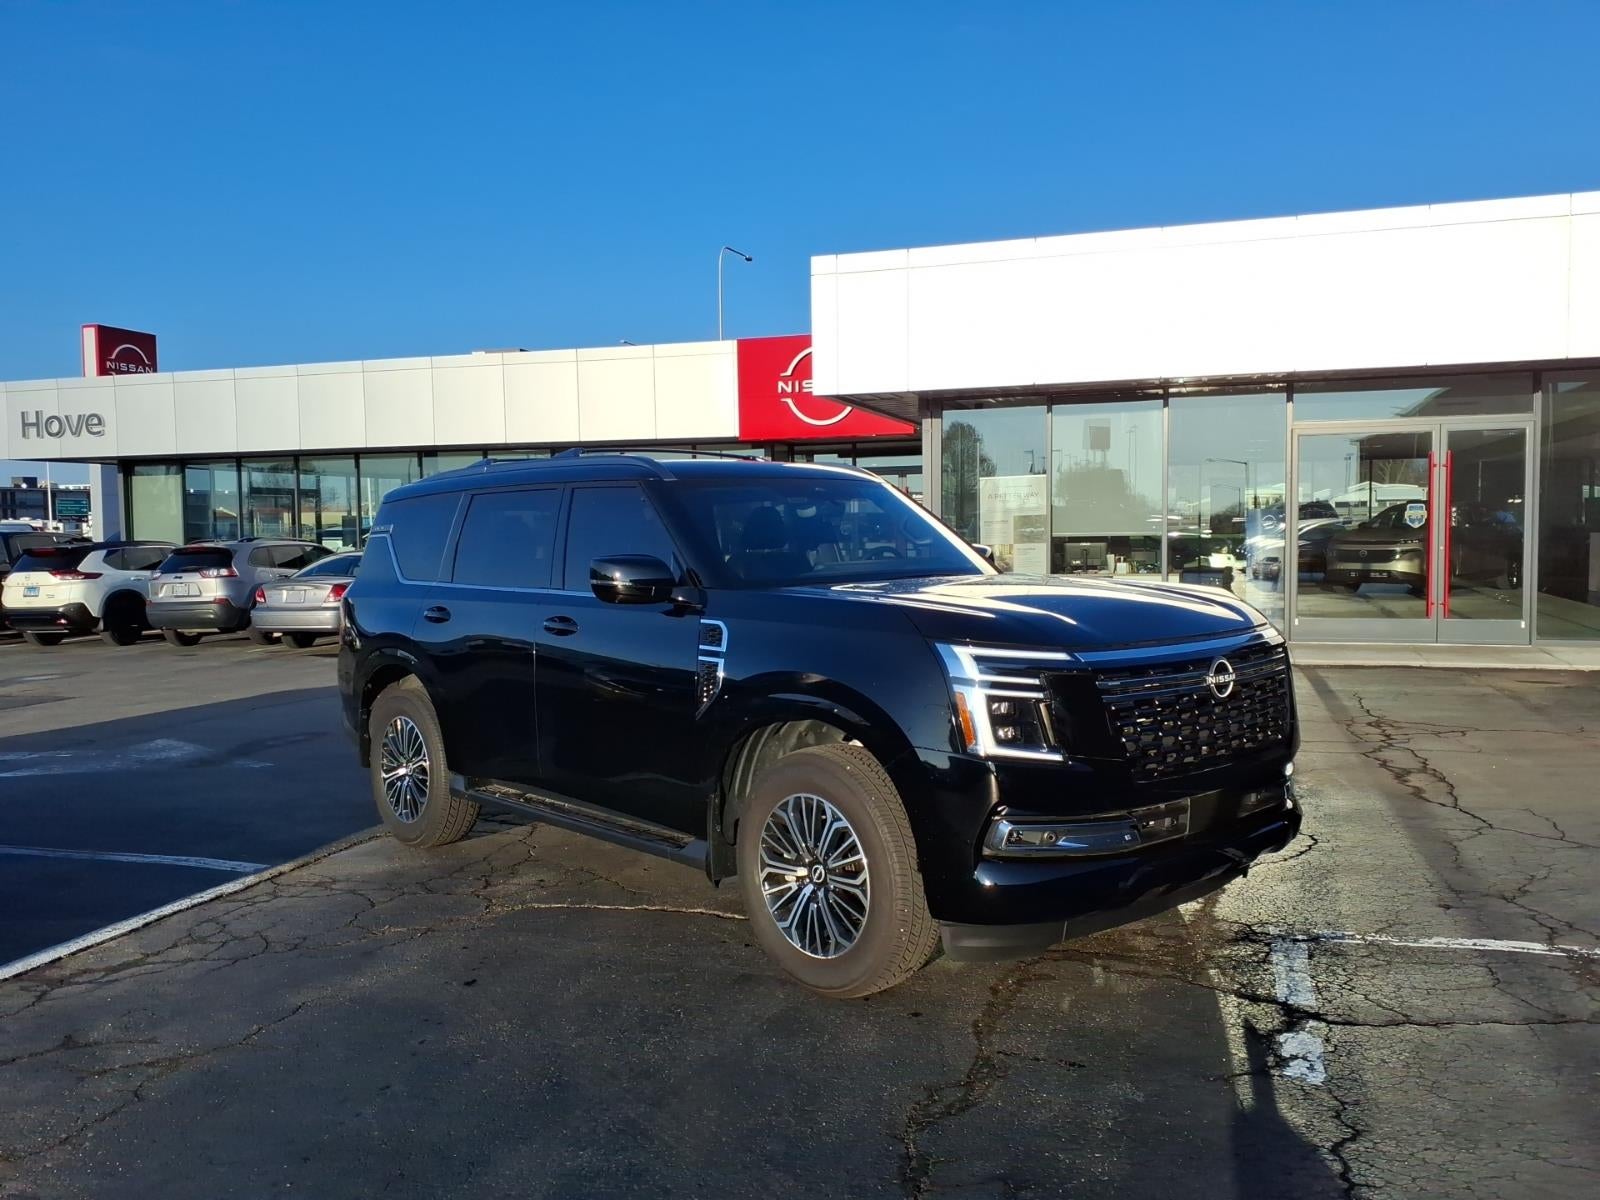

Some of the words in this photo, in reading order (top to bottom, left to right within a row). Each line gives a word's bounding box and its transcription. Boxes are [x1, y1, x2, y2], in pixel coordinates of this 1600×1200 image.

[106, 361, 153, 374] NISSAN
[778, 380, 813, 393] NIS
[21, 410, 105, 439] Hove
